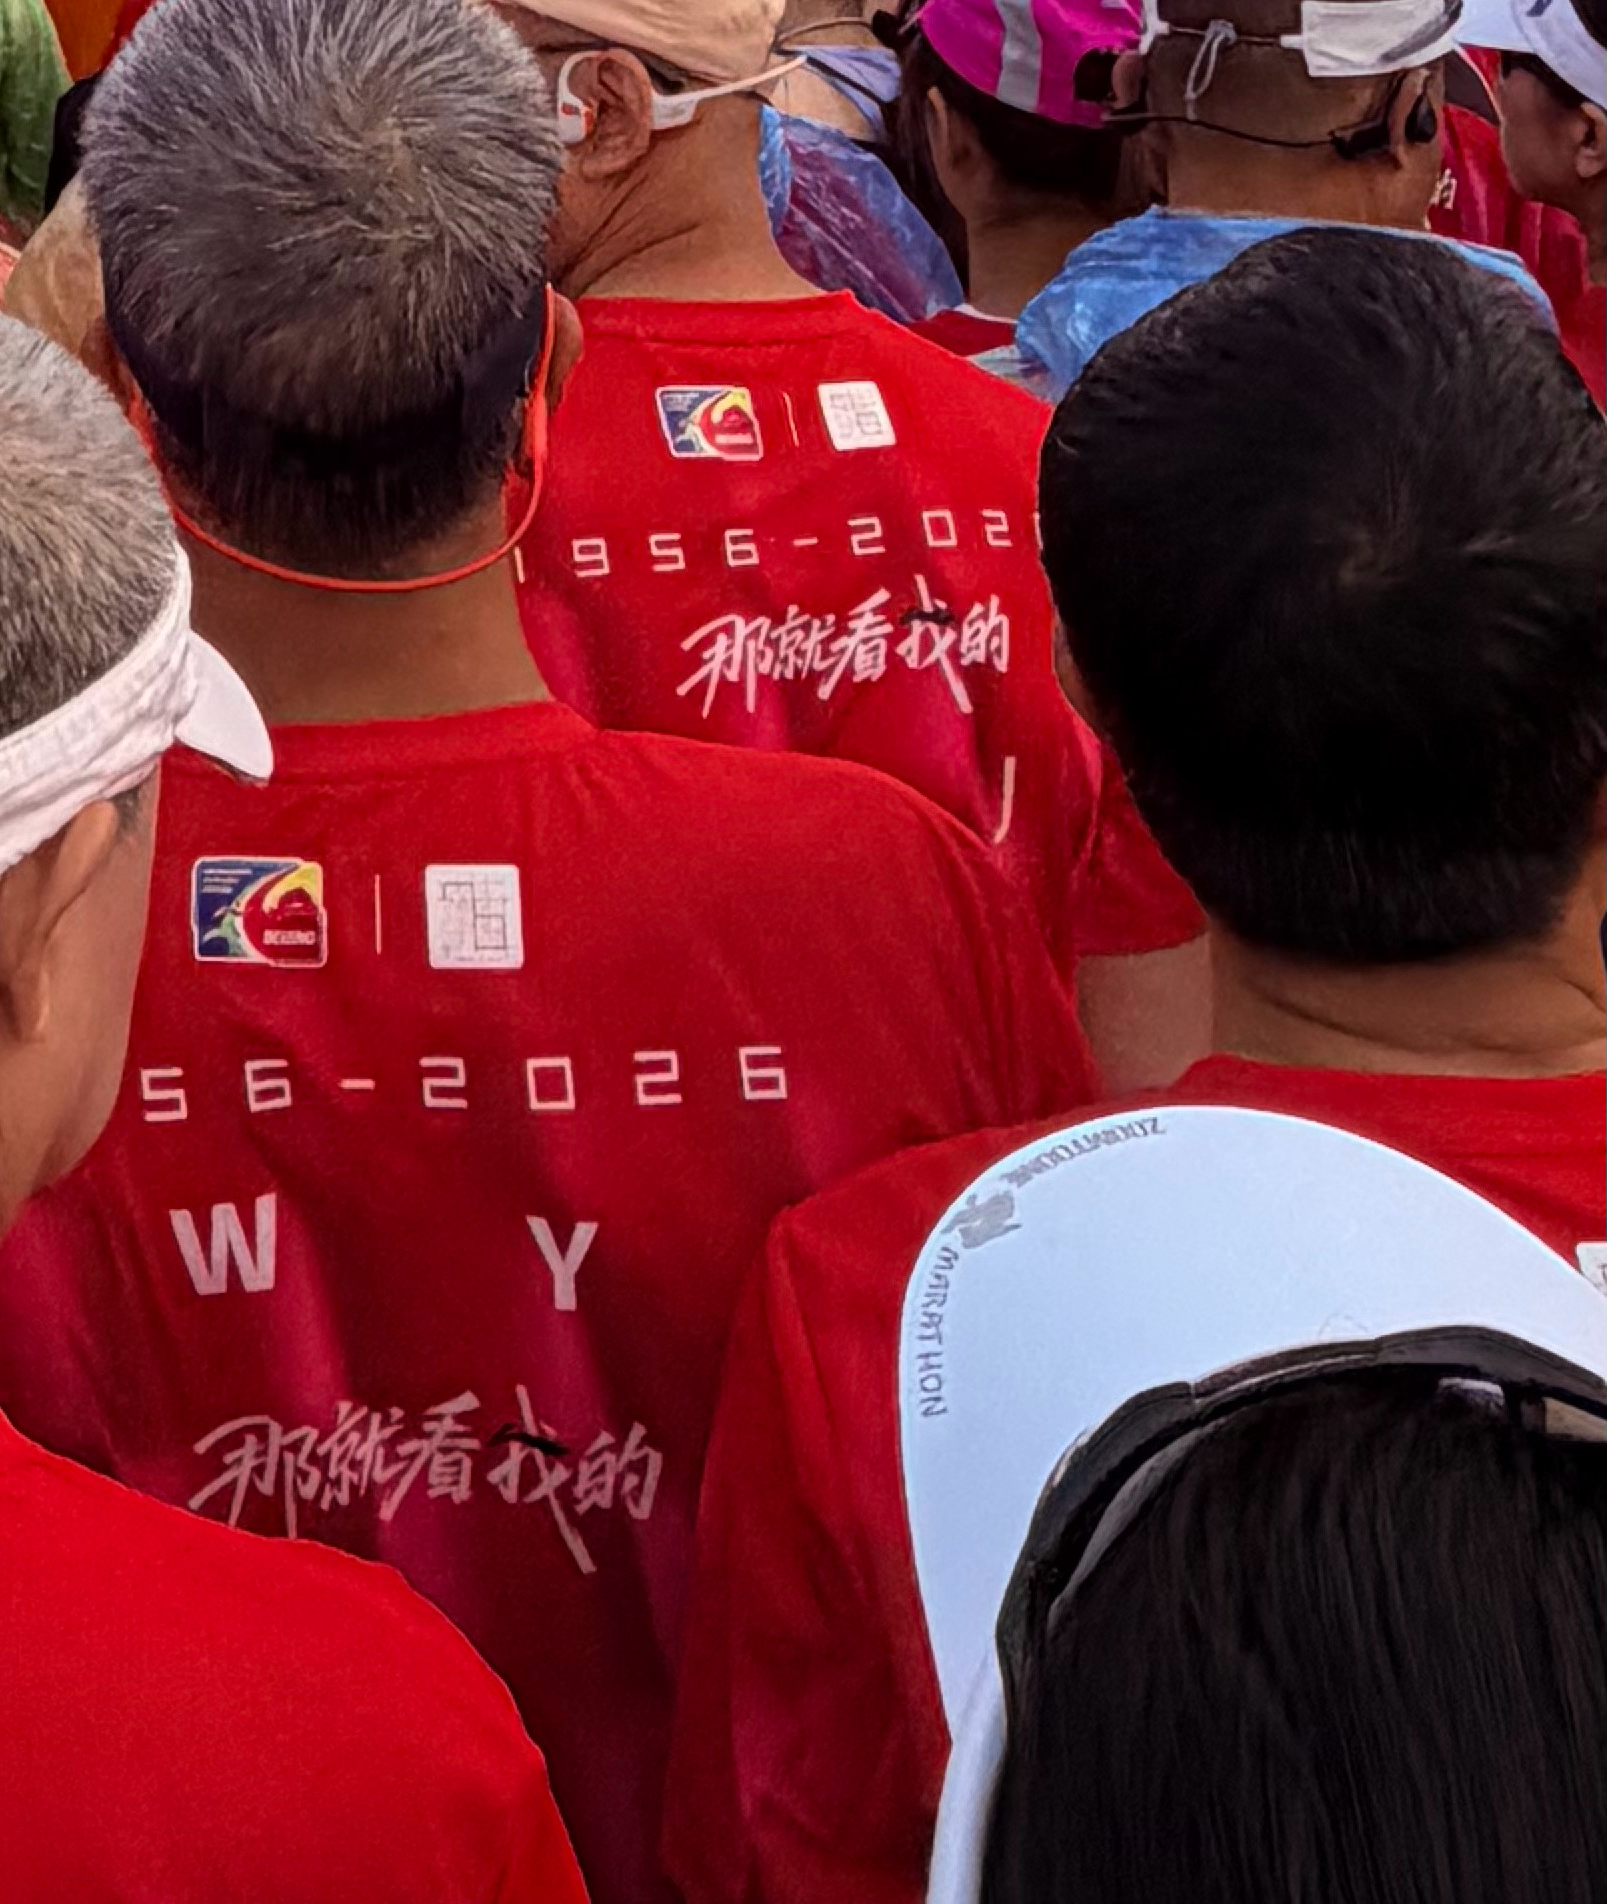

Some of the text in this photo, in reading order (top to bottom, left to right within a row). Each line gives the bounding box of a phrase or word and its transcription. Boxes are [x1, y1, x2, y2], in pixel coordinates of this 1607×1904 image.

[514, 508, 1044, 584] 1956-202
[676, 574, 1010, 718] 那就看我的
[916, 1244, 961, 1419] MARATHON
